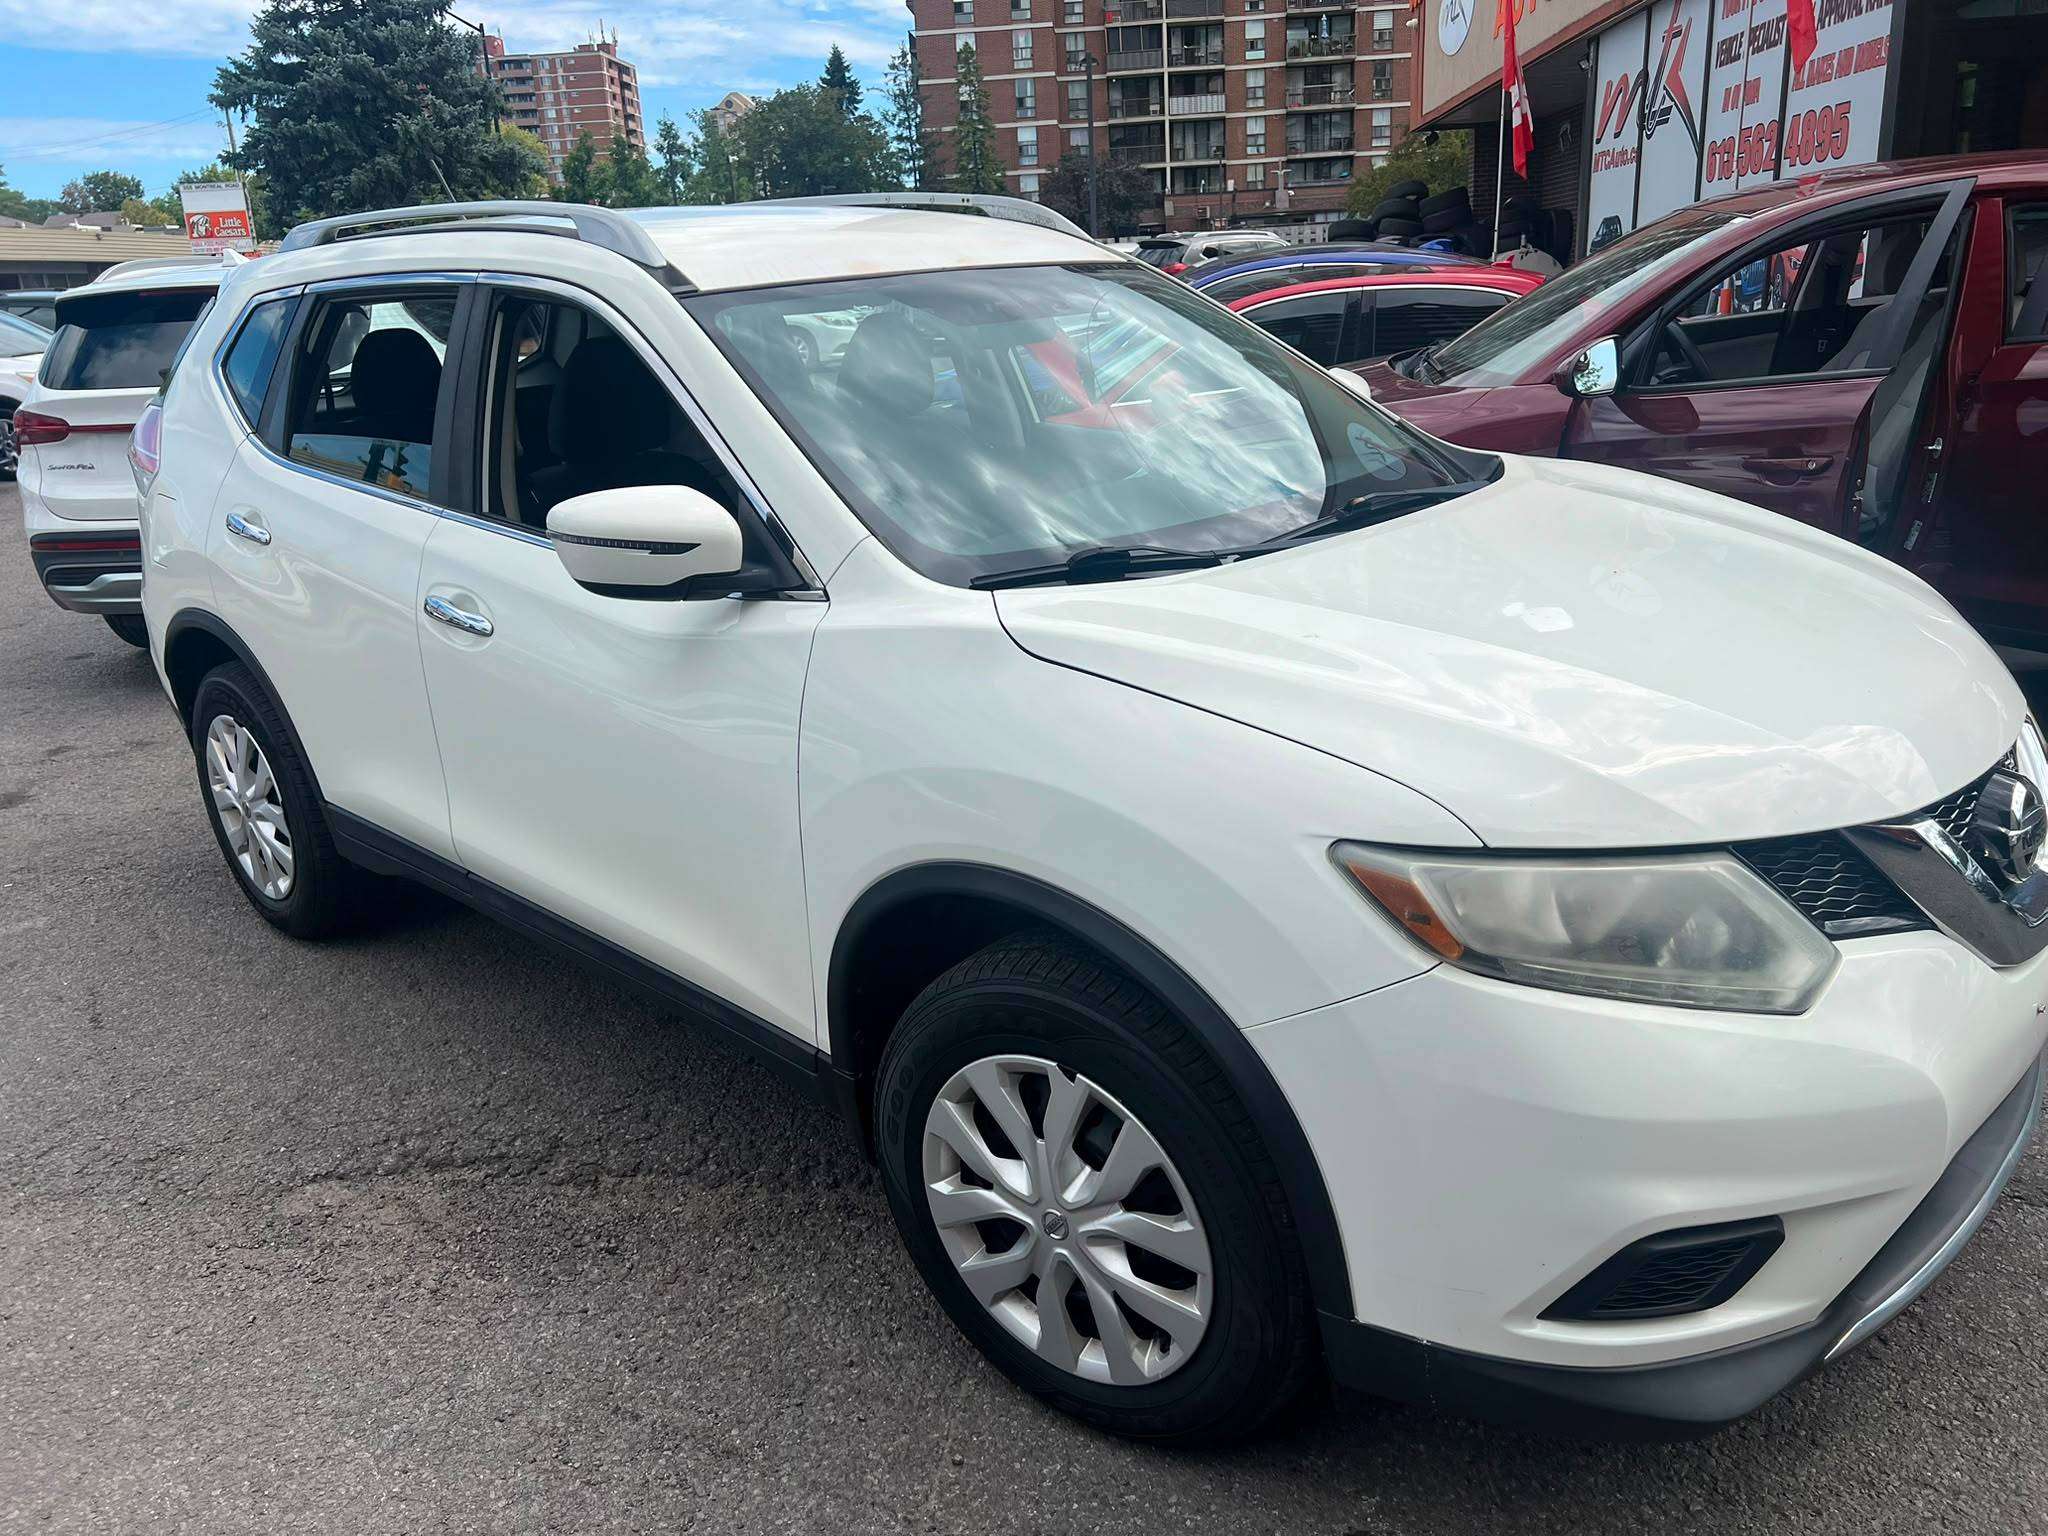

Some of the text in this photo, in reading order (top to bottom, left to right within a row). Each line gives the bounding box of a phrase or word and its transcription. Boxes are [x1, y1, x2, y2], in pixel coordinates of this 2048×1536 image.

[1715, 14, 1788, 69] VEHICLE PECIALIST
[1706, 100, 1852, 183] 613 562 4895
[214, 227, 247, 237] Caesars
[219, 217, 242, 227] Little
